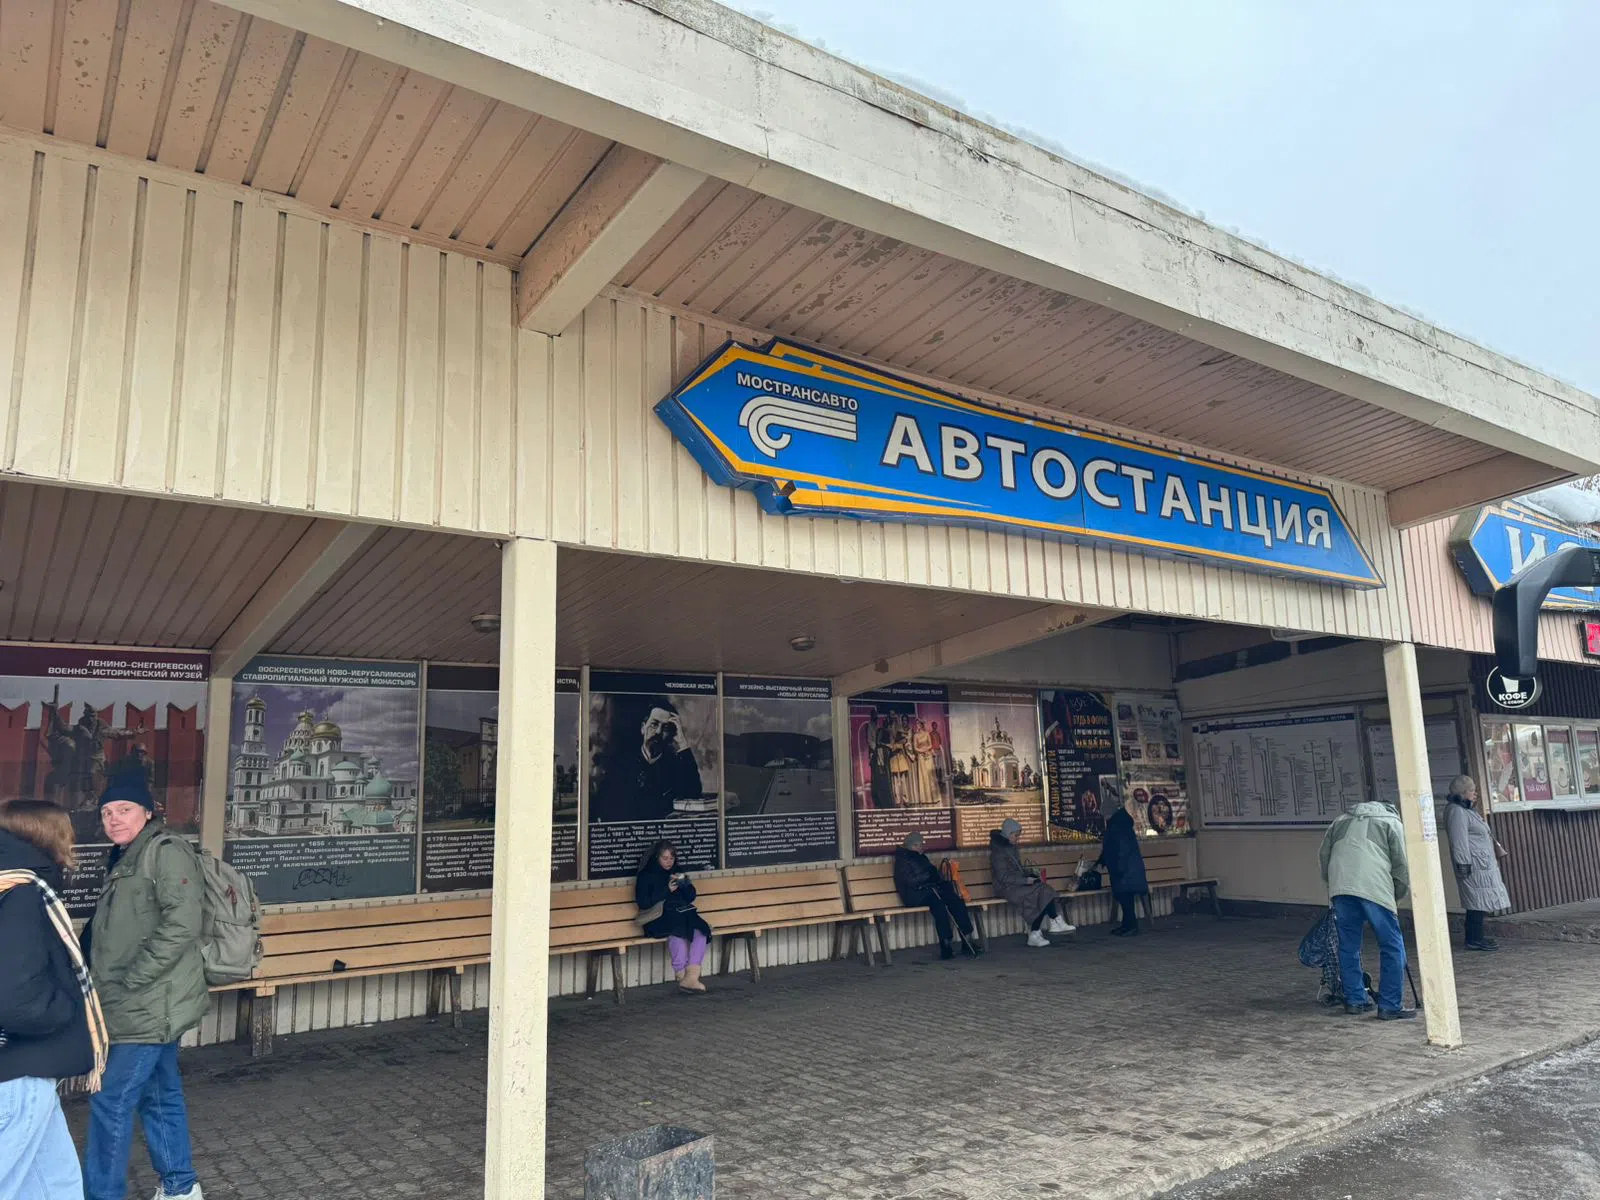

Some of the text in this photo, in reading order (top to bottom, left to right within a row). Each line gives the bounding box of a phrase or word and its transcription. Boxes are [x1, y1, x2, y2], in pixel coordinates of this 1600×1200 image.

[736, 371, 859, 411] МОСТРАНСАВТО
[880, 414, 1333, 550] АВТОСТАНЦИЯ
[87, 660, 203, 671] ЛЕНИНО-СНЕГИРЕВСКИЙ
[48, 667, 203, 679] ВОЕННО-ИСТОРИЧЕСКИЙ МУЗЕЙ
[258, 666, 417, 679] ВОСКРЕСЕНСКИЙ НОВО-ИЕРУСАЛИМСКИЙ
[242, 673, 417, 687] СТАВРОПИГИАЛЬНЫЙ МУЖСКОЙ МОНАСТЫРЬ
[664, 682, 696, 690] ЧЕХОВСКАЯ
[1498, 692, 1528, 701] КОФЕ
